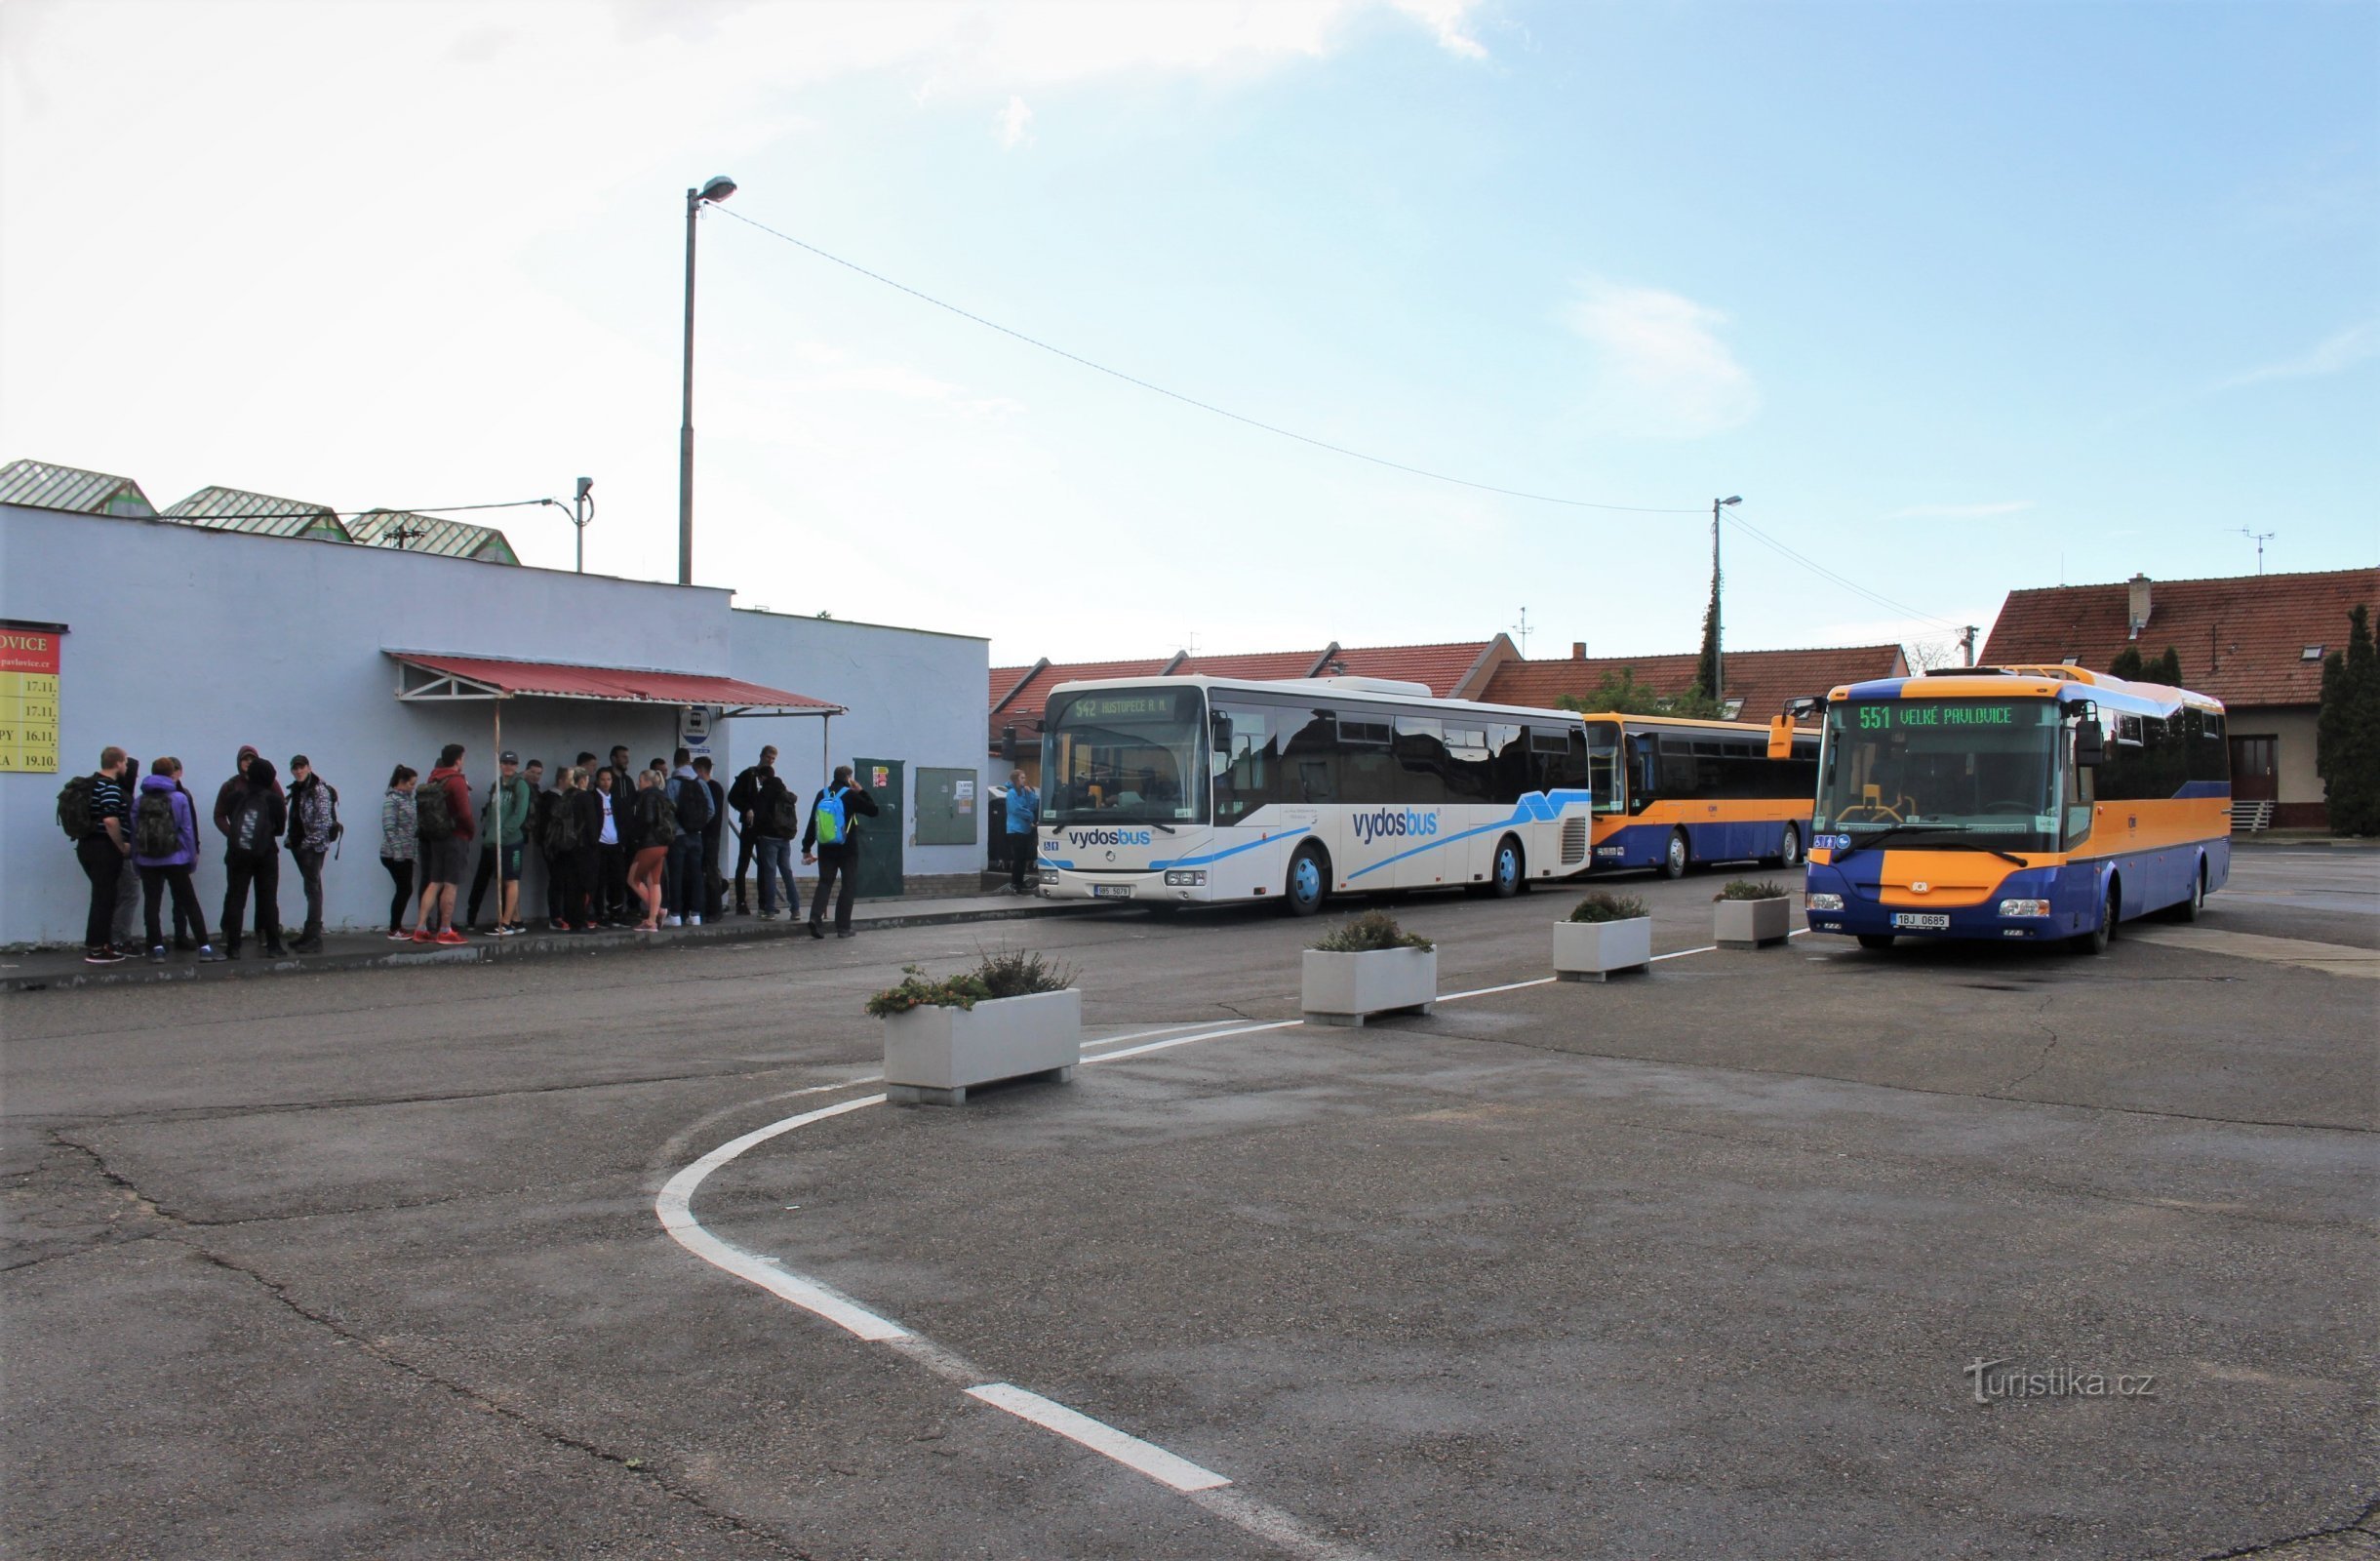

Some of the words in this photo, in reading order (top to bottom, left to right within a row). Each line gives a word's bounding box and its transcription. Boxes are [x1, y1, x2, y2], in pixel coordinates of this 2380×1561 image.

[27, 681, 57, 692] 17.11.
[26, 705, 57, 717] 17.11.
[1076, 700, 1097, 718] 542
[1859, 706, 1890, 729] 551
[1900, 705, 1938, 725] VELKÉ
[1944, 707, 2012, 724] PAVLOVICE
[26, 731, 57, 741] 16.11.
[25, 755, 57, 767] 19.10.
[1353, 807, 1437, 845] vydosbus
[1069, 828, 1151, 849] vydosbus
[1898, 915, 1916, 924] 1BJ
[1922, 915, 1945, 925] 0685
